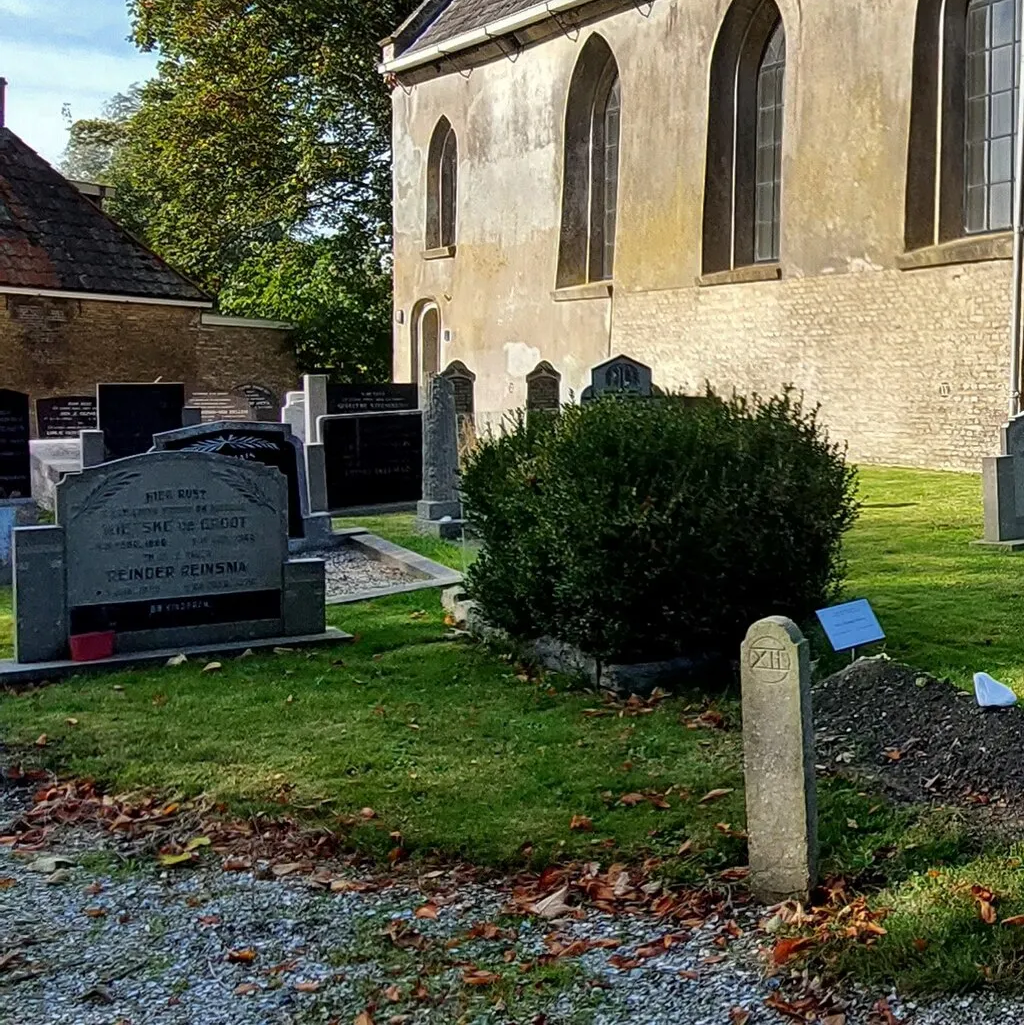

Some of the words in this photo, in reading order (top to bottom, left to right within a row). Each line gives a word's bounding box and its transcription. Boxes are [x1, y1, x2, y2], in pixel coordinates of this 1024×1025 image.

[177, 488, 207, 500] RUST
[107, 566, 175, 582] REINDER
[180, 561, 248, 577] REINSMA
